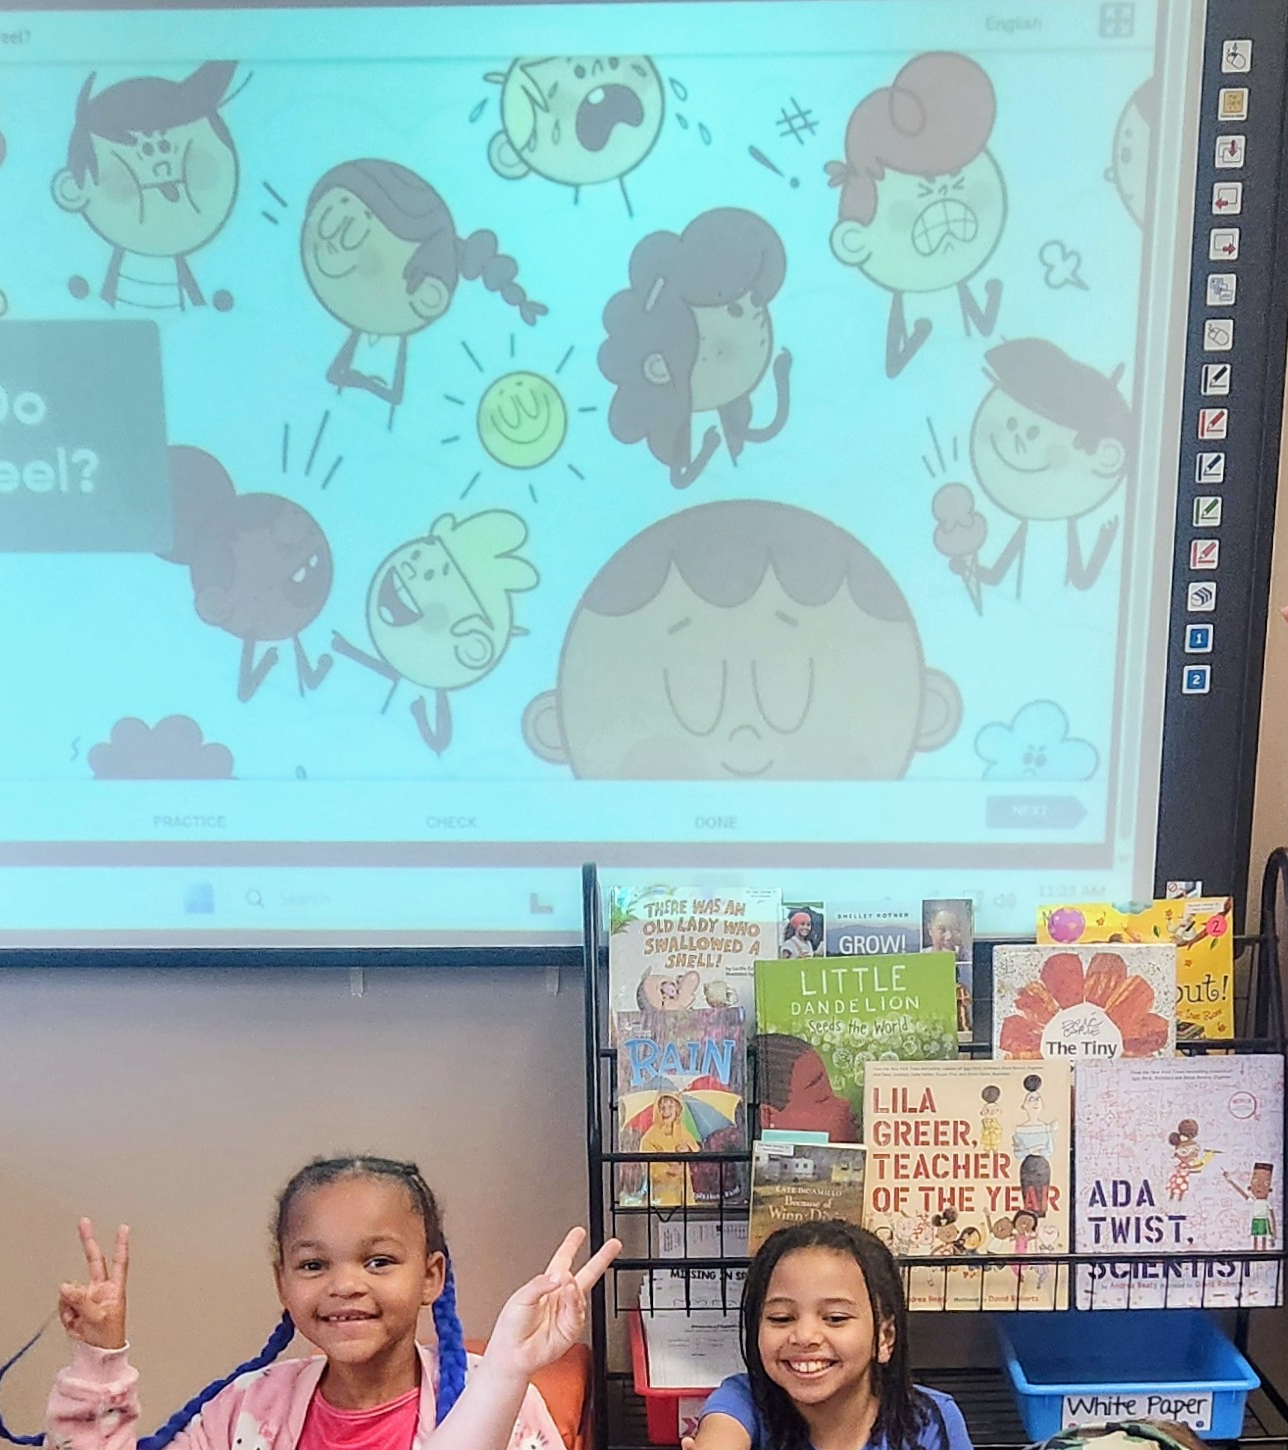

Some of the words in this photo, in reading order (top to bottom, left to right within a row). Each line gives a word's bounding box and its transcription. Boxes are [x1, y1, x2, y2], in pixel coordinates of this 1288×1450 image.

[985, 14, 1042, 34] English
[1013, 804, 1047, 816] NEXT
[153, 815, 227, 829] PRACTICE
[426, 815, 477, 829] CHECK
[694, 815, 738, 829] DONE
[643, 900, 688, 918] THERE
[693, 898, 721, 915] WAS
[724, 900, 746, 916] AN
[642, 920, 674, 936] OLD
[677, 917, 719, 933] LADY
[723, 920, 761, 937] WHO
[644, 935, 744, 955] SWALLOWED
[748, 940, 761, 956] A
[839, 935, 906, 954] GROW!
[665, 953, 723, 969] SHELL!
[801, 965, 907, 996] LITTLE
[791, 995, 920, 1016] DANDELION
[808, 1016, 842, 1034] Seeds
[848, 1018, 867, 1035] the
[874, 1016, 910, 1035] World
[1046, 1041, 1077, 1055] The
[1082, 1041, 1117, 1058] Tiny
[623, 1037, 736, 1087] RAIN
[873, 1087, 936, 1113] LILA
[872, 1120, 978, 1148] GREER,
[872, 1153, 1011, 1179] TEACHER
[784, 1195, 821, 1208] Because
[872, 1186, 910, 1213] OF
[918, 1186, 975, 1213] THE
[986, 1185, 1061, 1213] YEAR
[1088, 1179, 1155, 1208] ADA
[1088, 1214, 1194, 1245] TWIST,
[1066, 1395, 1137, 1416] White
[1147, 1395, 1208, 1420] Paper
